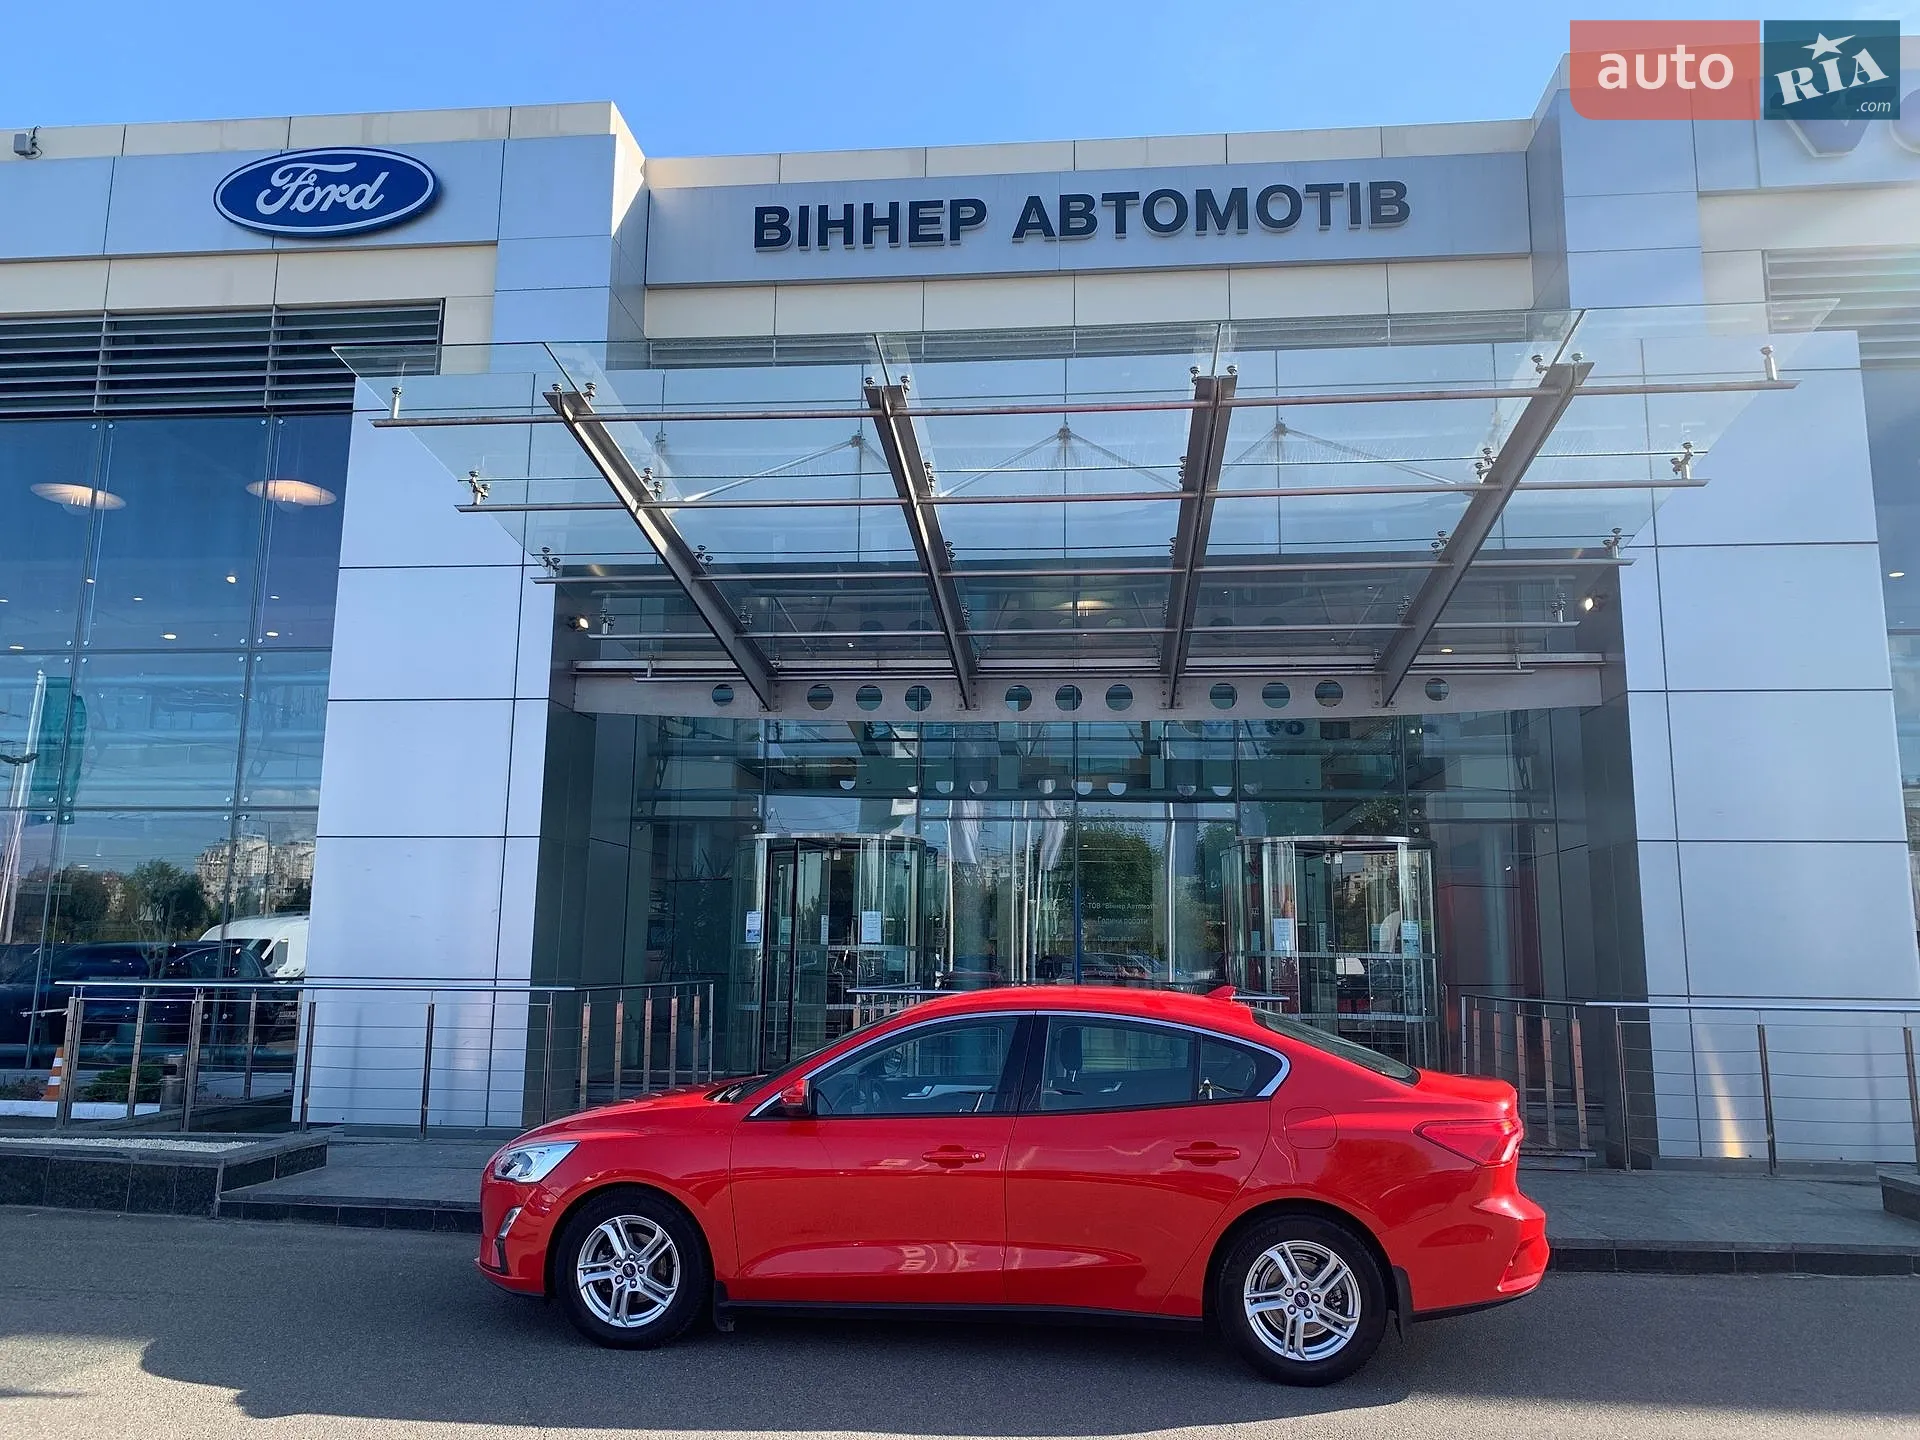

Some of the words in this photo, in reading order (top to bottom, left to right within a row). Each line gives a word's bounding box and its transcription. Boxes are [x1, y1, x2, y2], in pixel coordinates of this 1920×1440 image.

[255, 162, 389, 215] Ford
[754, 198, 988, 252] ВІННЕР
[1012, 180, 1411, 242] АВТОМОТІВ
